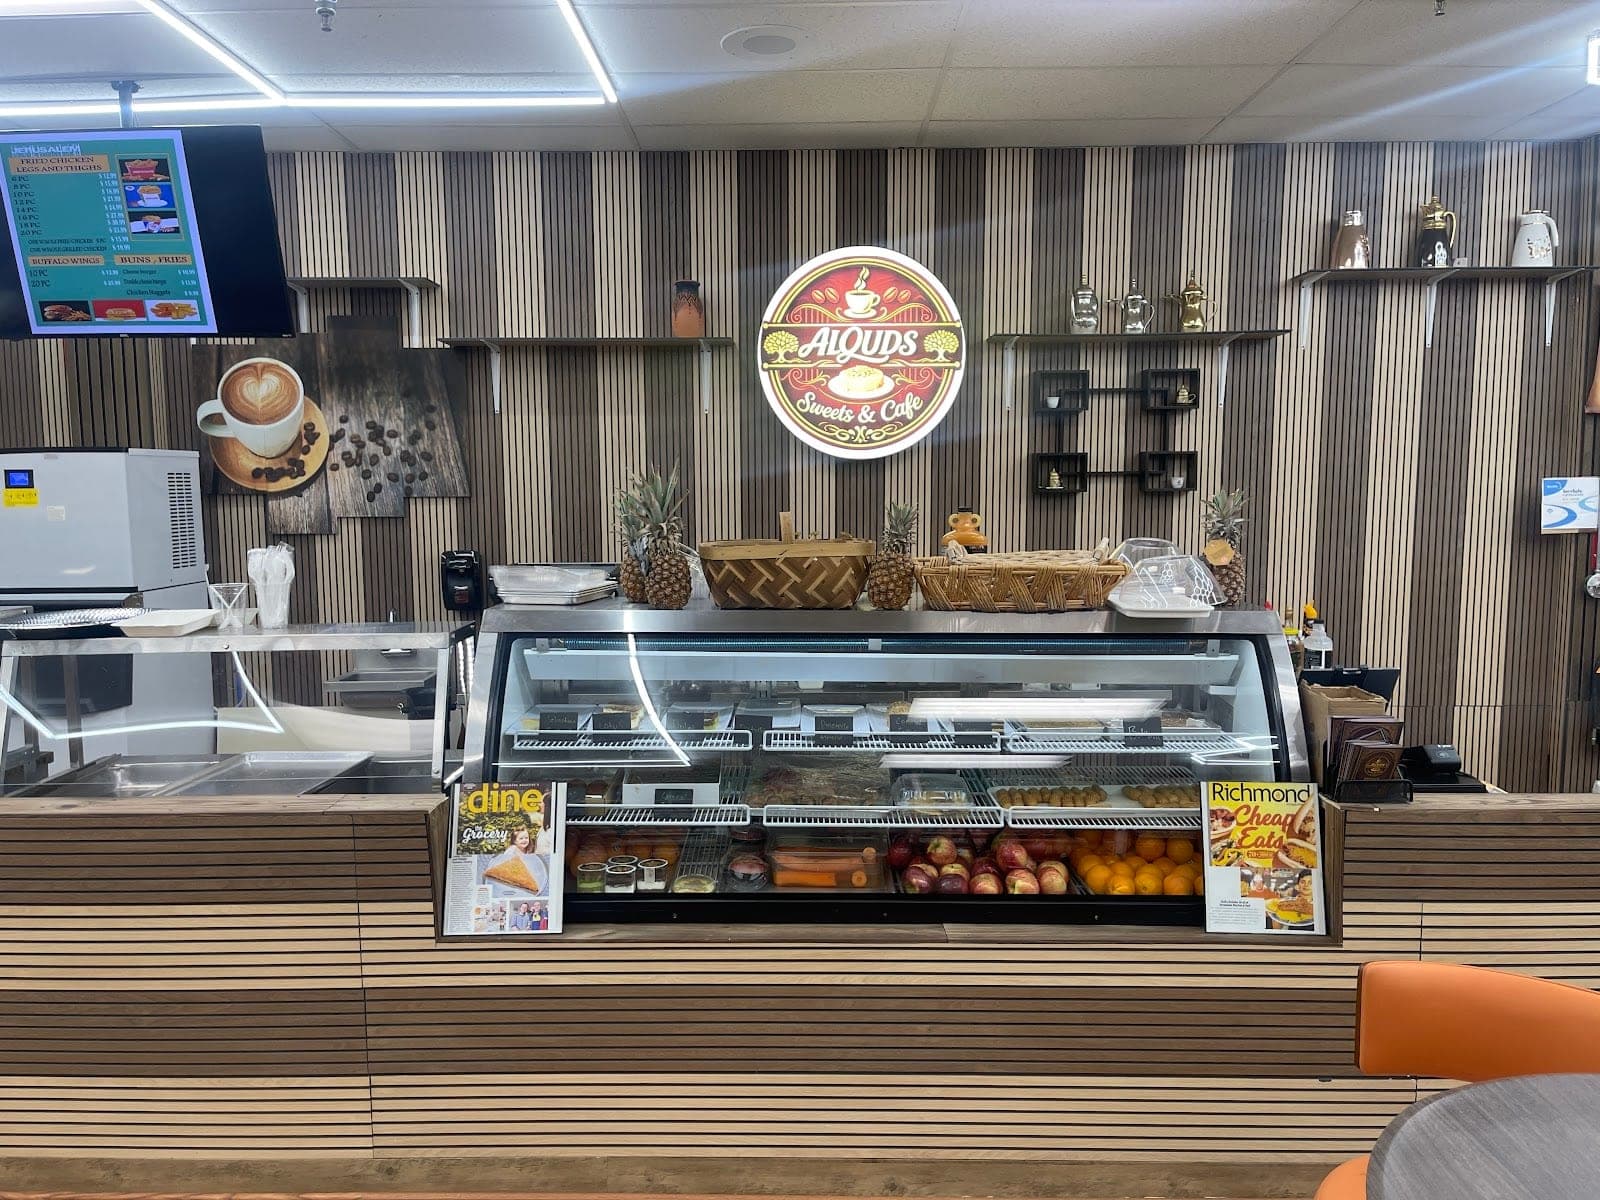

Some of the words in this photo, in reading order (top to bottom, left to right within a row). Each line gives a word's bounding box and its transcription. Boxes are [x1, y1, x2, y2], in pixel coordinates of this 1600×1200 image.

[11, 144, 81, 155] JERUSALEM
[40, 269, 48, 277] PC
[796, 392, 856, 423] Sweets
[857, 405, 876, 423] &
[880, 392, 924, 421] Cafe
[467, 783, 544, 813] dine
[1213, 783, 1310, 803] Richmond
[1232, 804, 1296, 832] Cheap
[462, 828, 508, 843] Grocery
[1236, 826, 1287, 850] Eats
